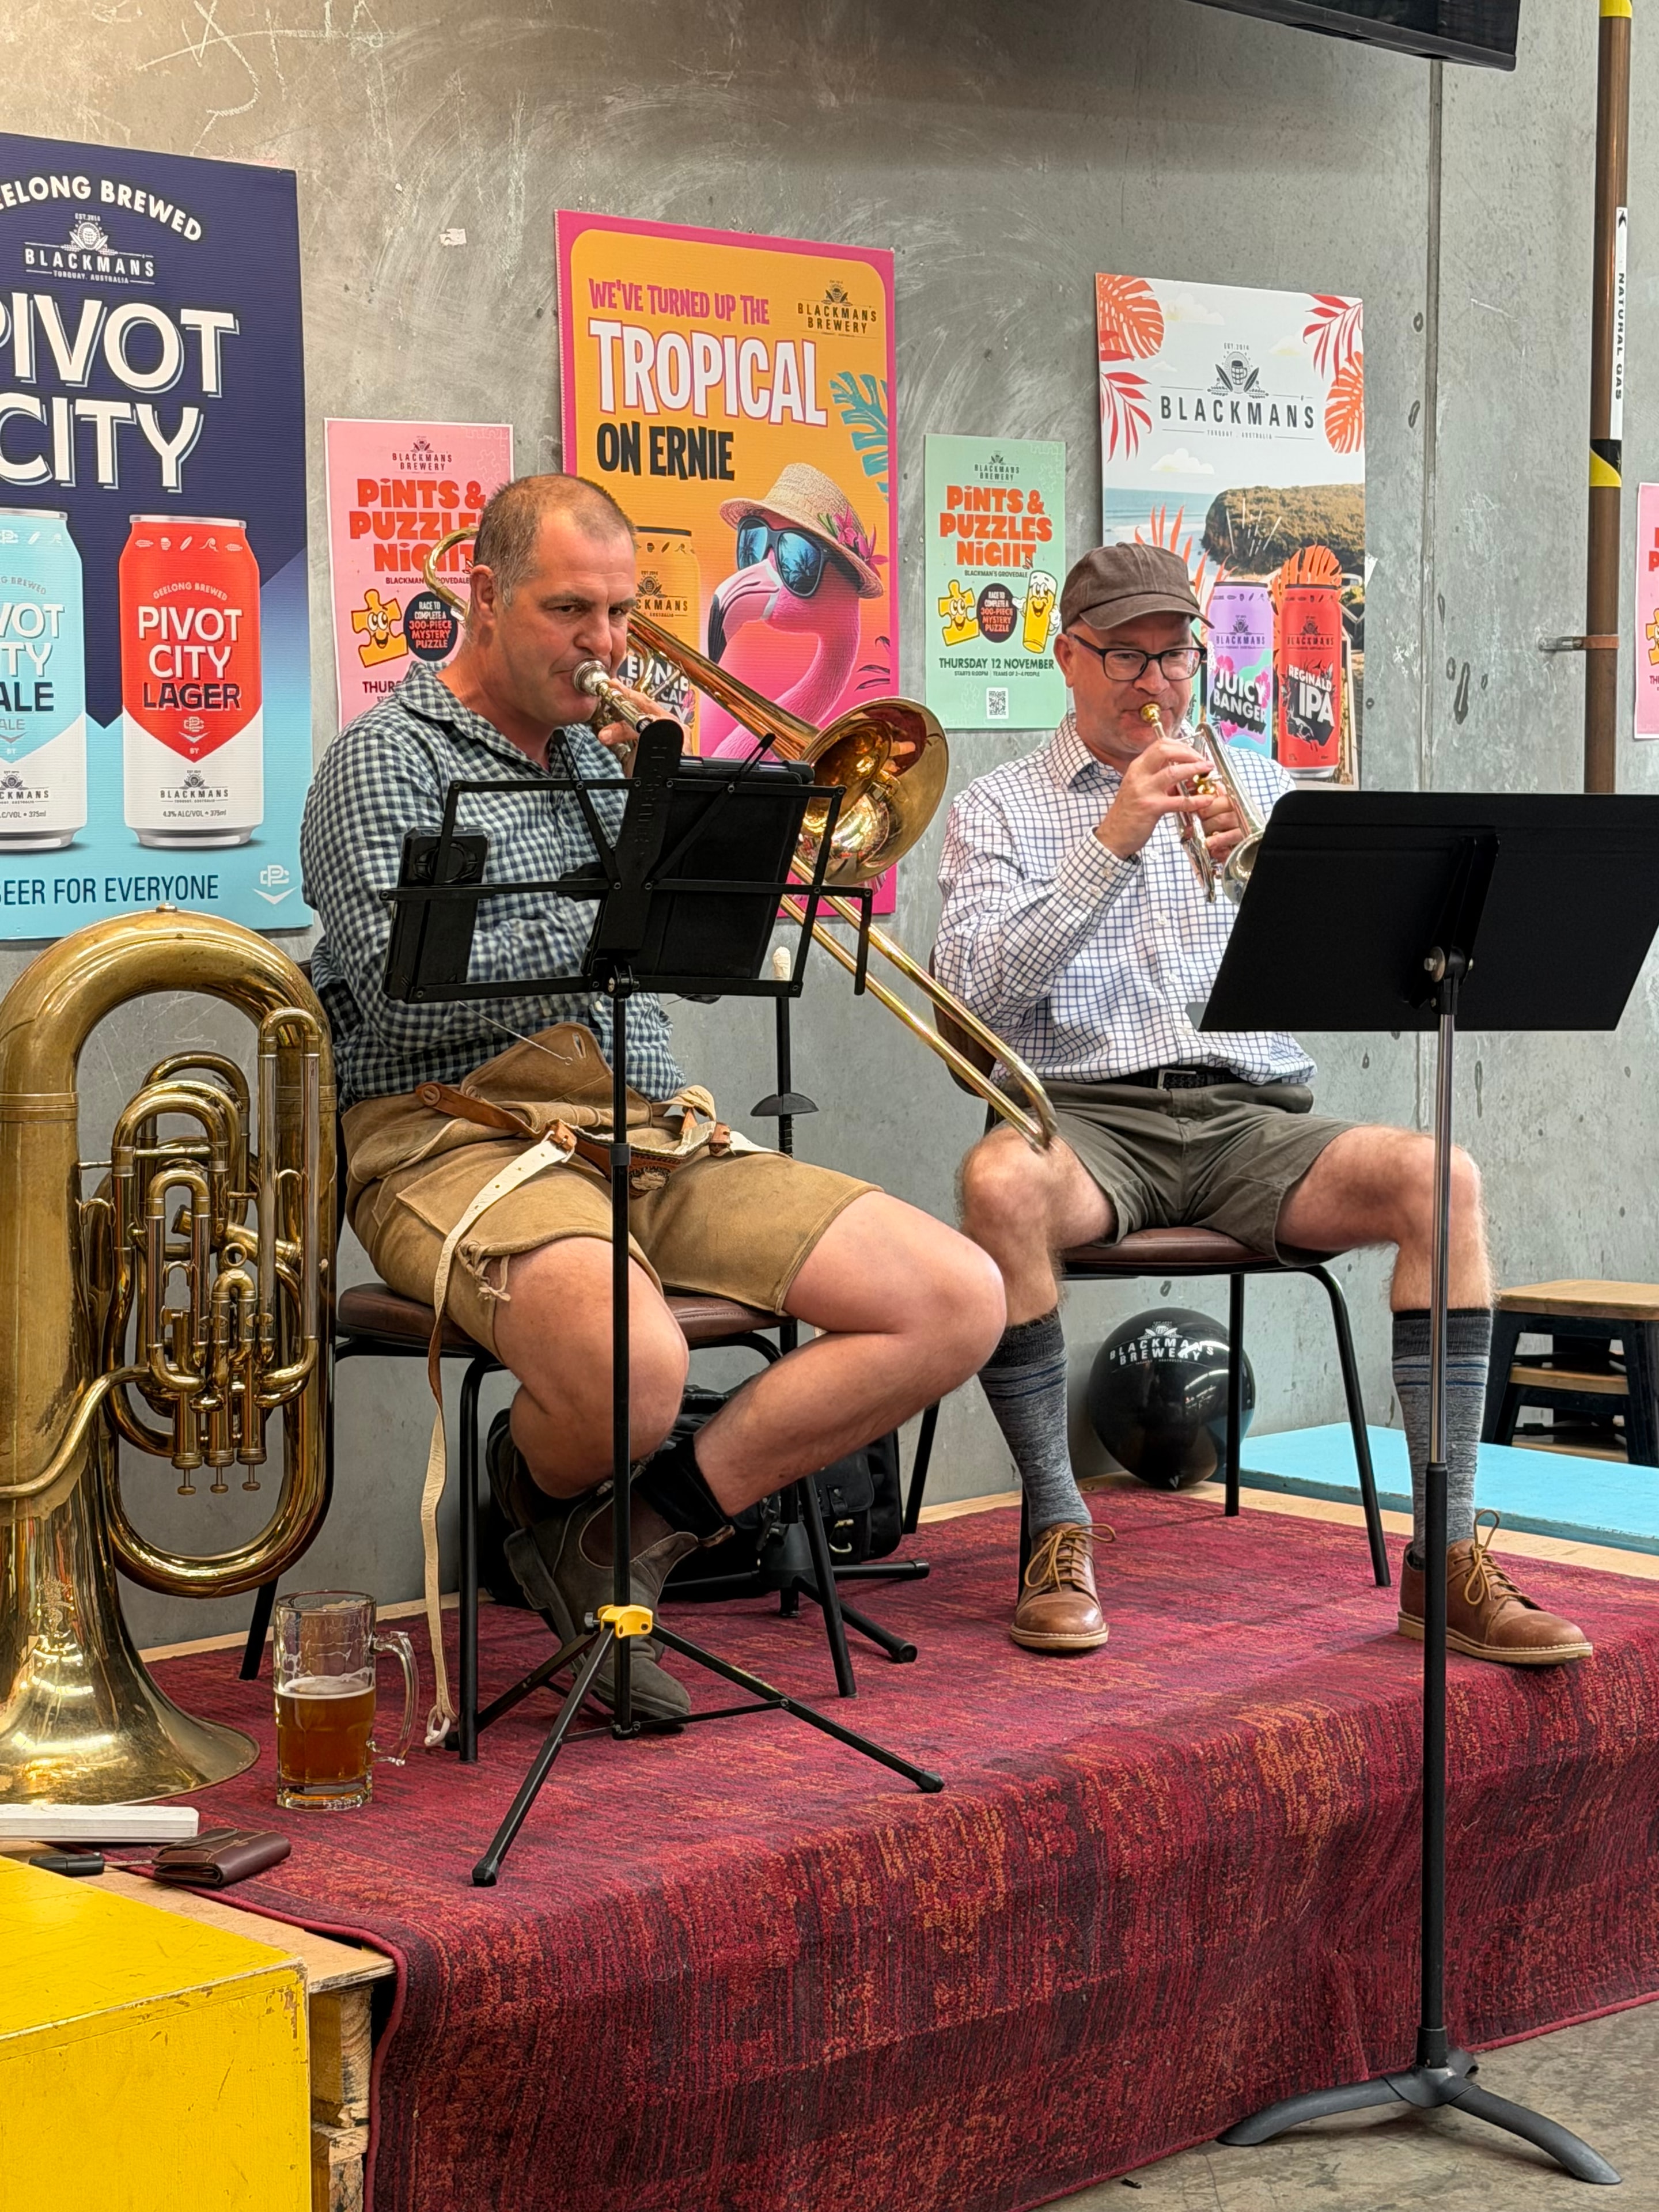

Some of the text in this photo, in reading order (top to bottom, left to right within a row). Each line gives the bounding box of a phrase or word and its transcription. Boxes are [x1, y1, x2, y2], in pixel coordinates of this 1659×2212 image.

[0, 175, 202, 241] ELONG BREWED
[25, 248, 154, 277] BLACKMANS
[90, 274, 128, 284] AUSTRALIA
[589, 278, 770, 325] WE'VE TURNED UP THE
[808, 317, 867, 334] BREWERY
[0, 291, 239, 398] IVOT
[588, 317, 828, 427] TROPICAL
[0, 393, 204, 493] CITY
[597, 420, 734, 482] ON ERNIE
[400, 461, 445, 471] BREWERY
[979, 472, 1014, 482] BREWERY
[357, 478, 486, 510] PiNTS &
[946, 485, 1046, 515] PiNTS &
[349, 510, 482, 541] PUZZLE
[940, 512, 1053, 542] PUZZLES
[957, 540, 1037, 569] NiGHT
[11, 577, 47, 594] BREWED
[153, 582, 228, 601] GEELONG BREWED
[414, 611, 440, 620] COMPLETE
[419, 601, 433, 609] RACE
[138, 605, 244, 642] PIVOT
[408, 620, 452, 630] 300-PIECE
[411, 630, 450, 639] MYSTERY
[982, 616, 1012, 624] MYSTERY
[984, 624, 1009, 632] PUZZLE
[415, 639, 448, 649] PUZZLE
[149, 643, 232, 680] CITY
[939, 658, 1054, 670] THURSDAY 12 NOVEMBER
[362, 680, 403, 694] THUR
[1216, 667, 1266, 705] JUICY
[1288, 664, 1332, 692] REGINALD
[143, 682, 242, 711] LAGER
[1213, 688, 1266, 723] BANGER
[1299, 681, 1335, 728] IPA
[160, 789, 229, 798] BLACKMANS
[0, 874, 219, 906] EER FOR EVERYONE
